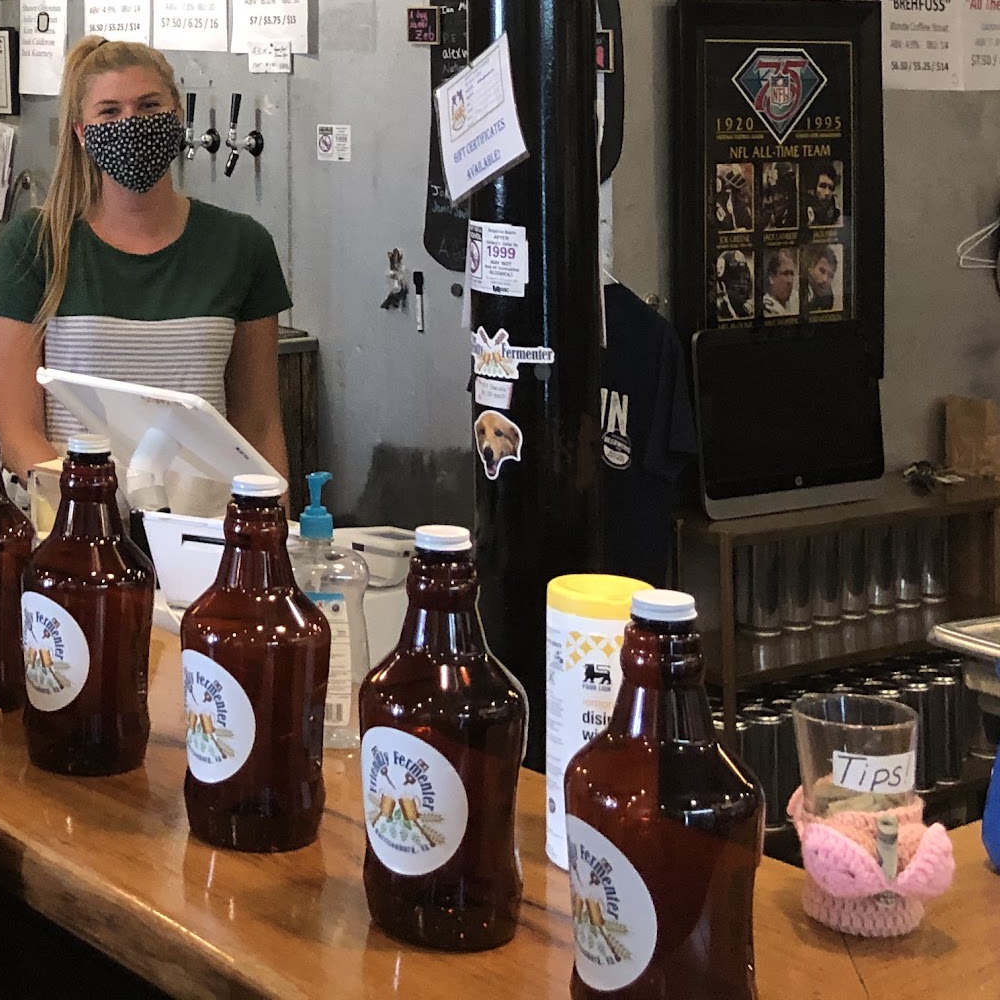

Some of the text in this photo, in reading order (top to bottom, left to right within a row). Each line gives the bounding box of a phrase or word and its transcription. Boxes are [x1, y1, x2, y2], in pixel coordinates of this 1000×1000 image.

[210, 18, 219, 29] 16
[772, 86, 790, 103] NFL
[716, 116, 841, 131] 1920 1995
[729, 144, 831, 160] NFL ALL-TIME TEAM
[486, 245, 516, 260] 1999
[501, 343, 553, 361] Fermenter
[35, 611, 65, 661] Fermenter
[196, 671, 228, 728] Fermenter
[582, 729, 600, 741] wi
[393, 750, 436, 812] Fermenter
[579, 843, 620, 921] Fermenter
